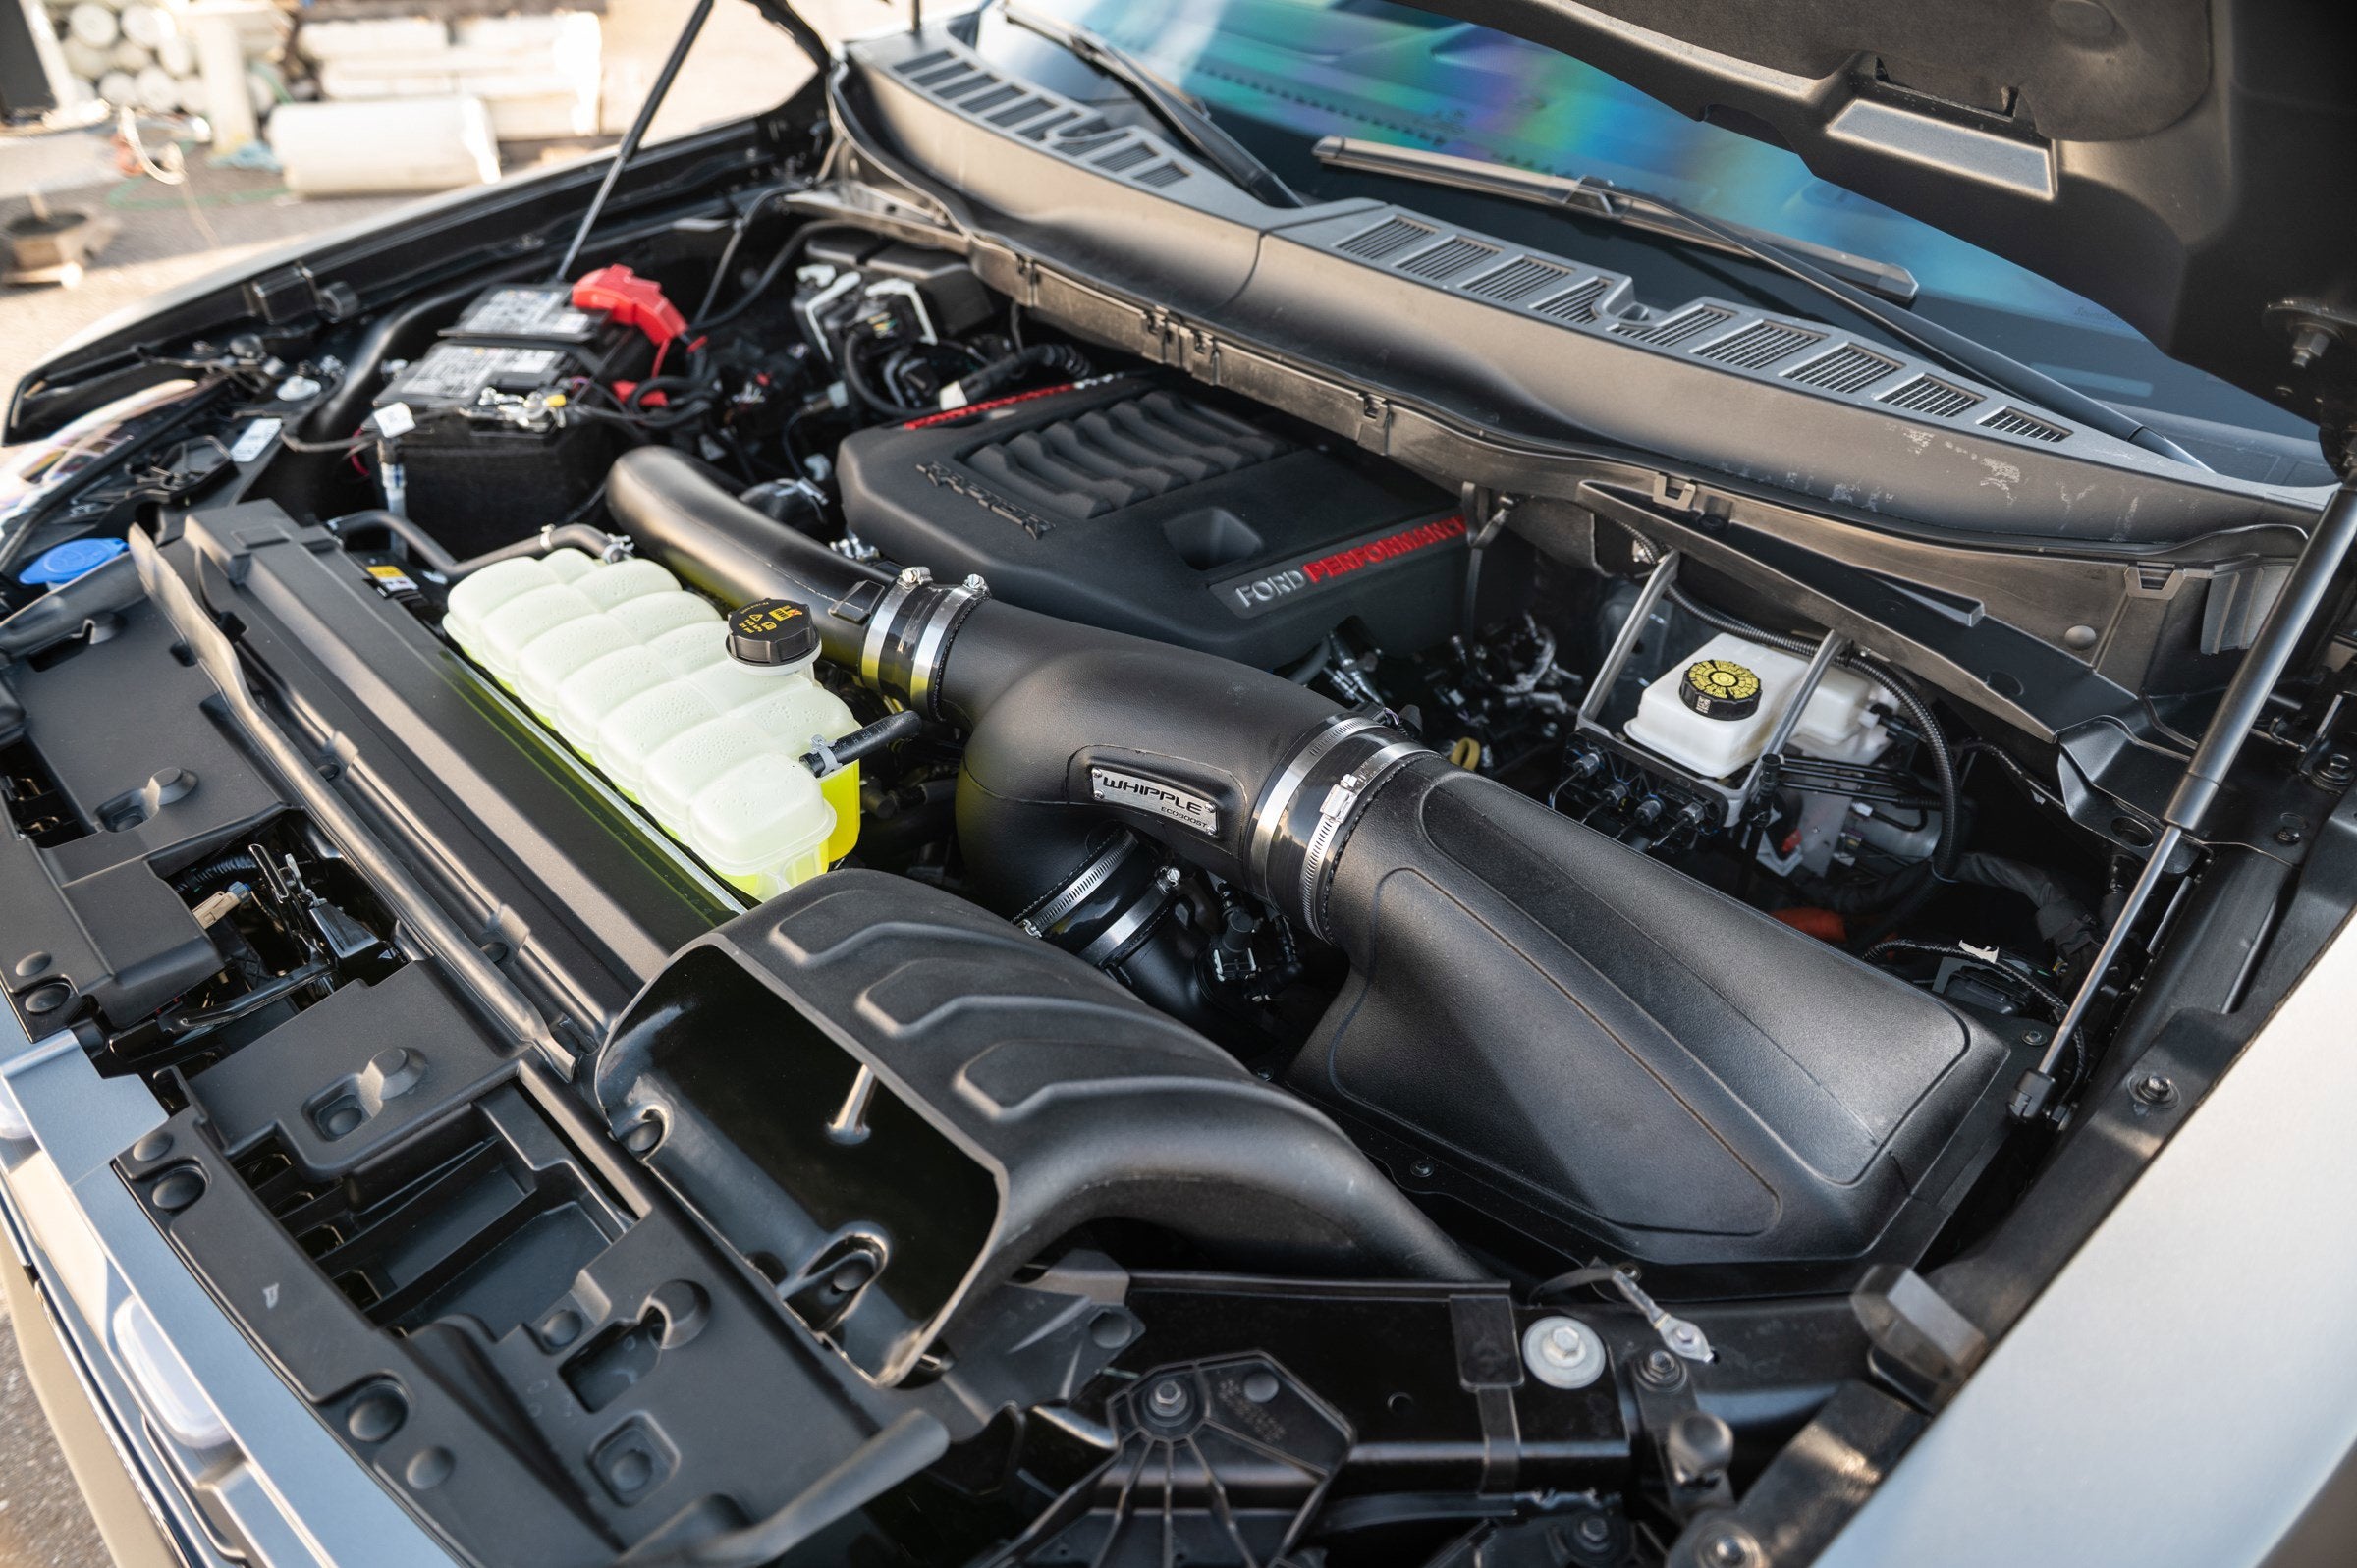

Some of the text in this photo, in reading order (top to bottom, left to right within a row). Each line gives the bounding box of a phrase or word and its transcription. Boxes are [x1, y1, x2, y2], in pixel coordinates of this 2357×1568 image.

[1234, 569, 1307, 608] FORD
[1103, 776, 1203, 816] WHIPPLE
[1161, 806, 1208, 828] ECOBOOST
